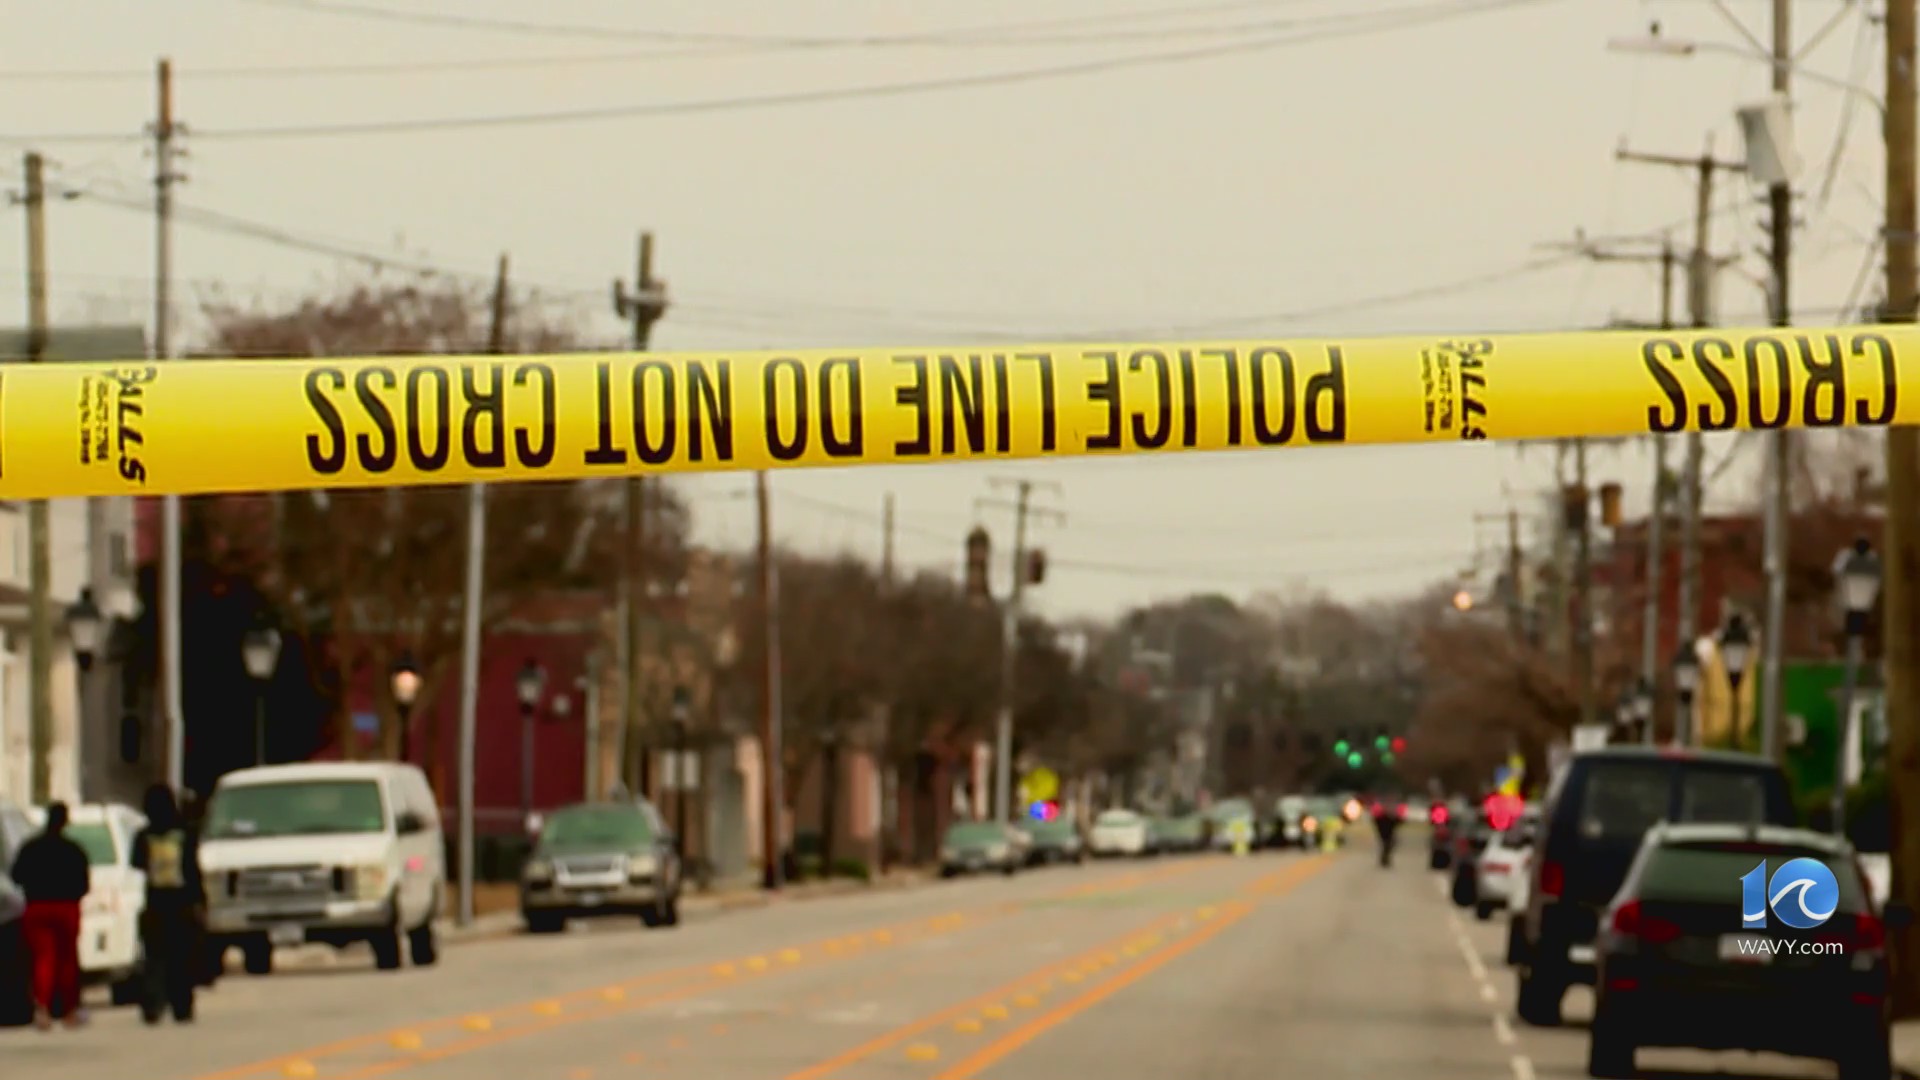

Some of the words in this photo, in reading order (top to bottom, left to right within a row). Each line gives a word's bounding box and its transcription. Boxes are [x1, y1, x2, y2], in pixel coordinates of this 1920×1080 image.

[304, 362, 556, 475] CROSS
[584, 359, 733, 465] NOT
[764, 357, 864, 463] DO
[893, 353, 1056, 457] LINE
[1083, 347, 1346, 451] POLICE
[1642, 334, 1897, 432] CROSS
